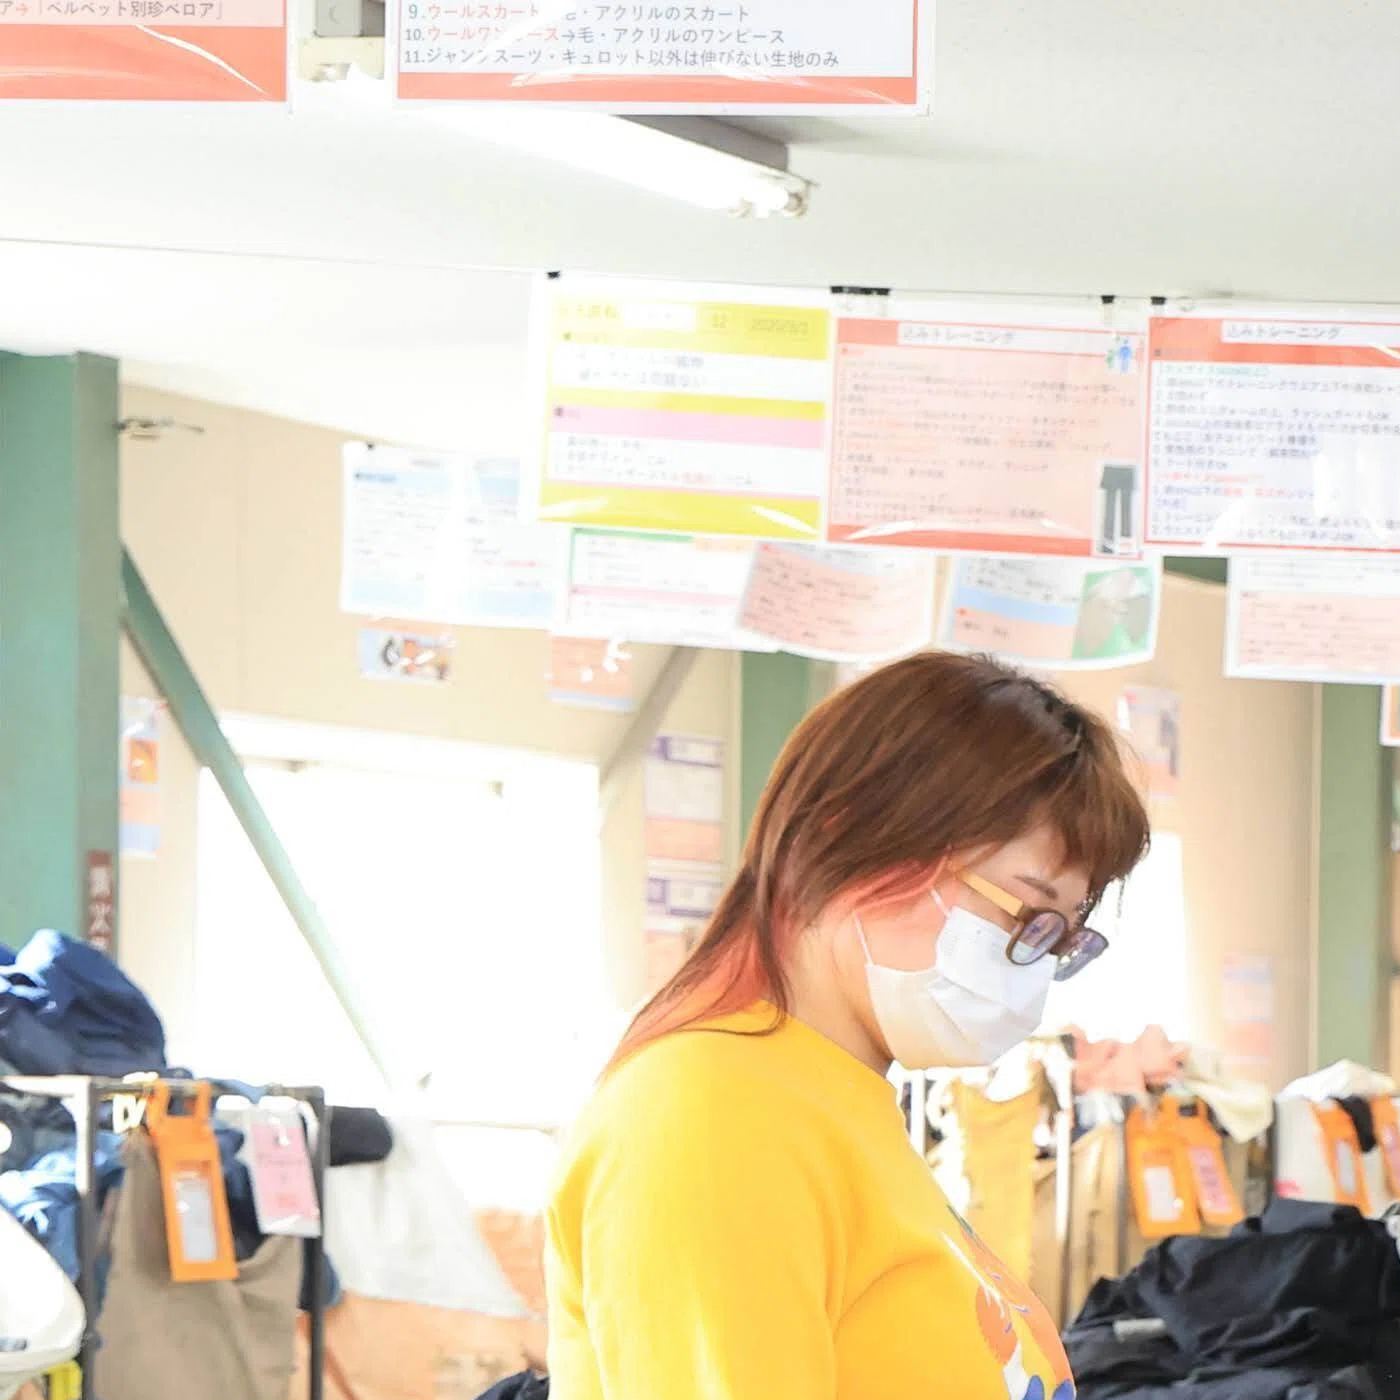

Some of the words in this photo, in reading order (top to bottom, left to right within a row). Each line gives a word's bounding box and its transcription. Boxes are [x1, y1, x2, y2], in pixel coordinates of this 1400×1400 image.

[405, 26, 558, 42] 10.ウールワース
